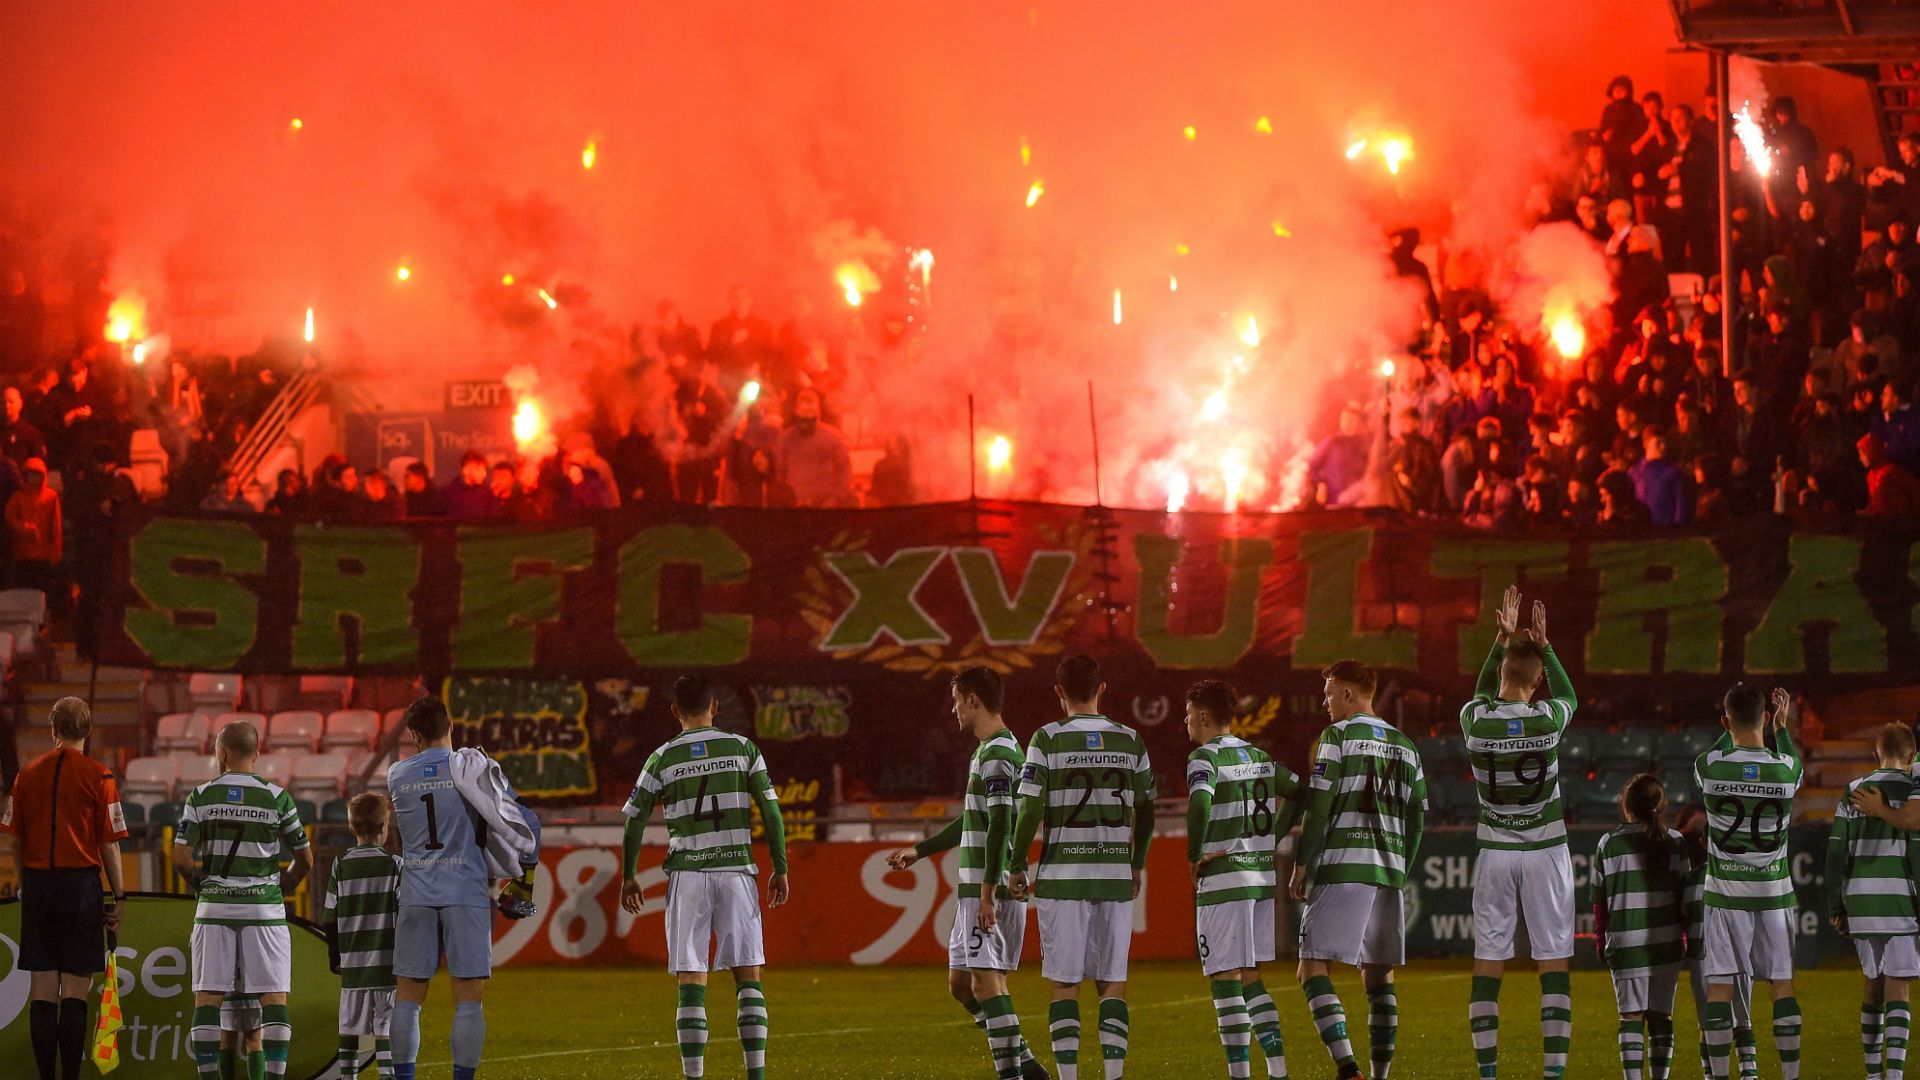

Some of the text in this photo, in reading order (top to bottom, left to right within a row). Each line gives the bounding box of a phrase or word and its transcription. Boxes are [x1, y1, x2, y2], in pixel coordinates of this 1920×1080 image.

[450, 385, 503, 407] EXIT
[124, 517, 1920, 675] SRFC XV ULTRA
[1499, 737, 1554, 750] HYUNDAI
[688, 759, 738, 774] HYUNDAI
[1080, 755, 1129, 765] HYUNDAI
[413, 780, 454, 791] HYUND
[1359, 756, 1406, 816] 14
[1480, 750, 1548, 806] 19
[1729, 783, 1787, 796] HYUNDAI
[693, 774, 725, 833] 4
[1066, 770, 1128, 829] 23
[1238, 778, 1273, 838] 18
[220, 808, 270, 821] HYUNDAI
[420, 792, 445, 851] 1
[1714, 795, 1785, 854] 20
[217, 819, 246, 880] 7
[684, 851, 717, 861] maldron
[234, 888, 267, 896] HOTELS
[969, 926, 983, 950] 5
